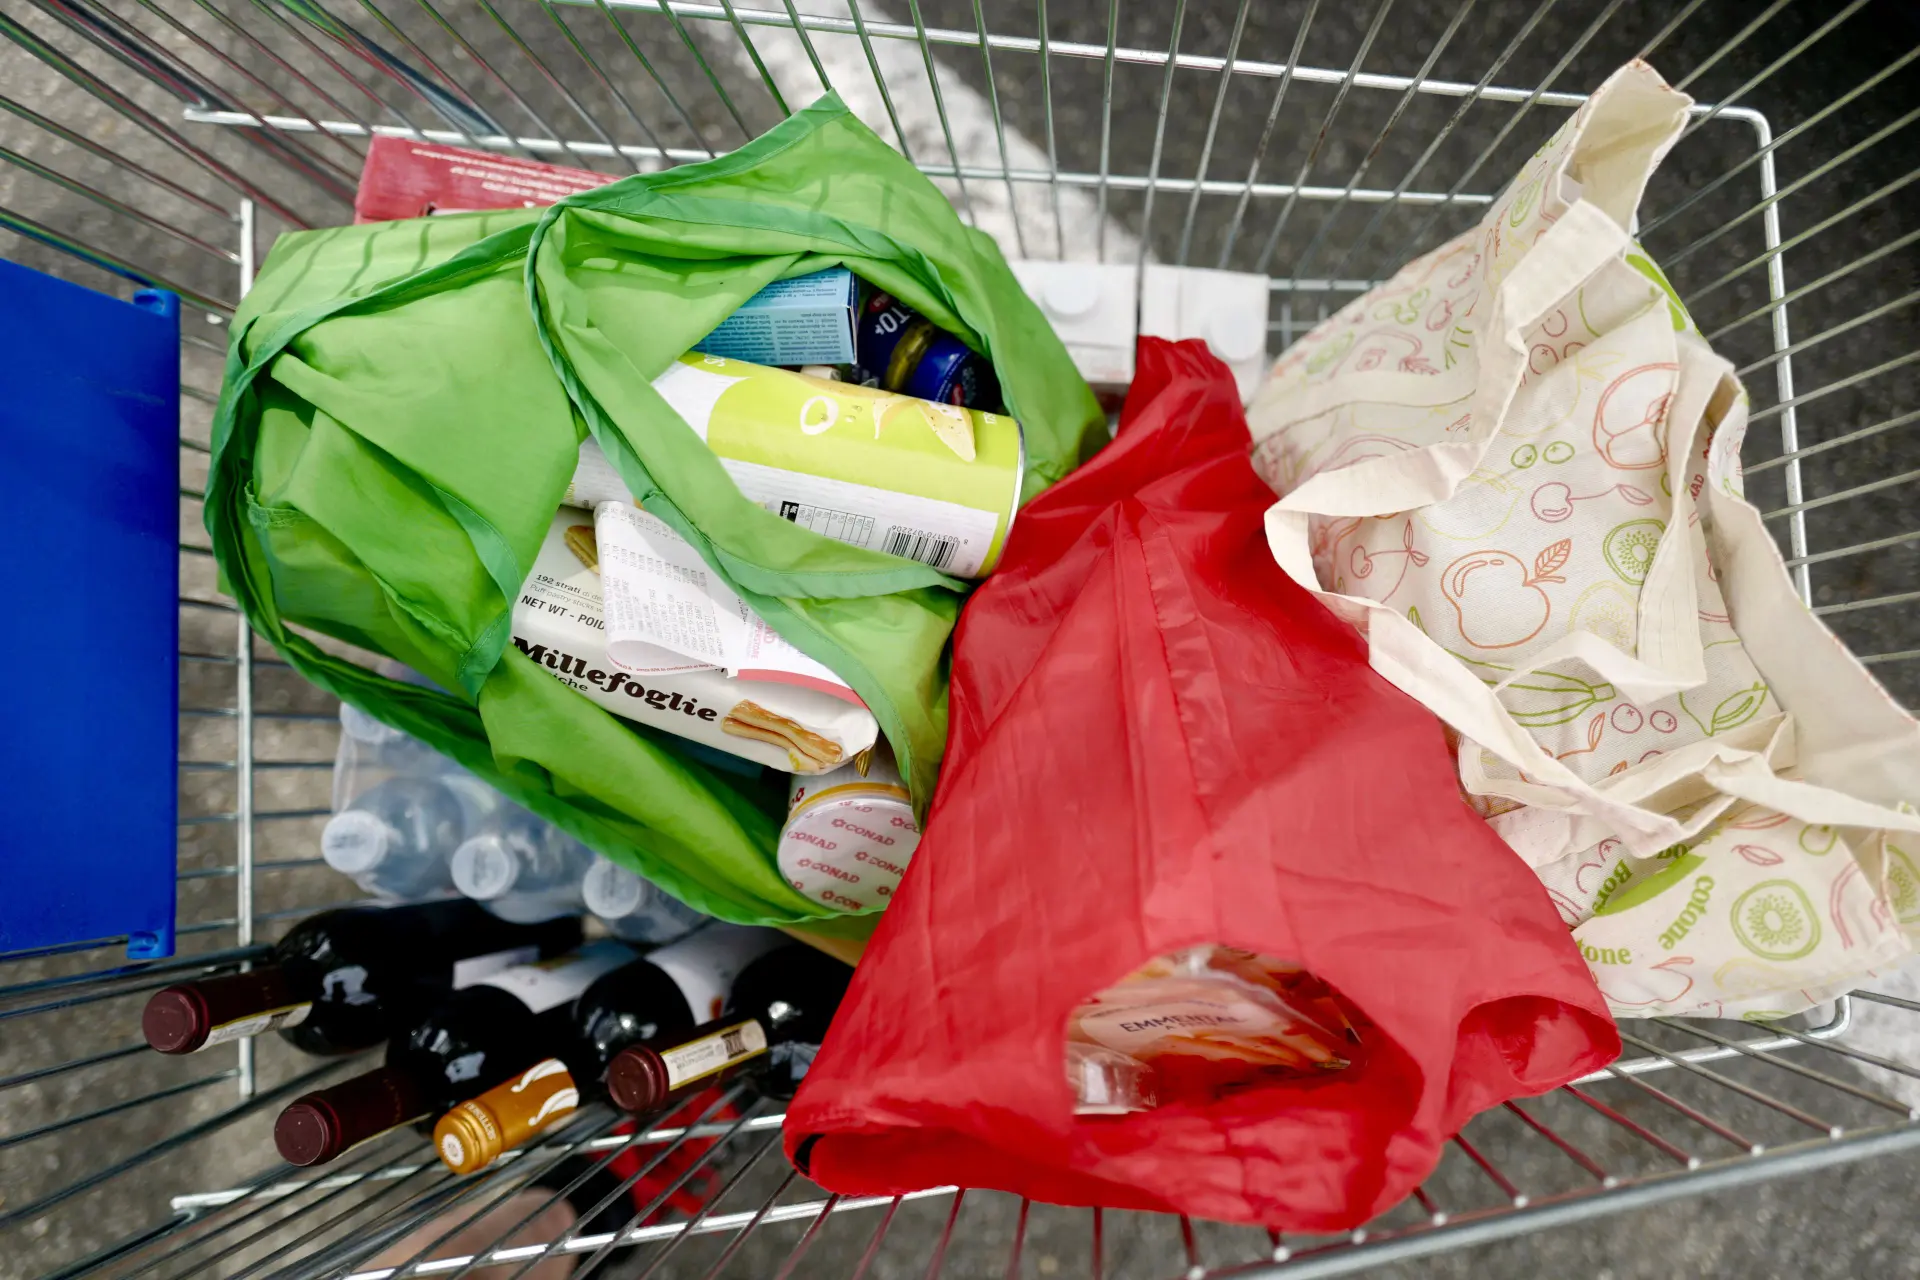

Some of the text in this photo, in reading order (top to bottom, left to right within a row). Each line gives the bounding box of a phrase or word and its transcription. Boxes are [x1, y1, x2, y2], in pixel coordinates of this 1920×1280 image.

[530, 583, 546, 593] Puff
[546, 589, 571, 602] pastry
[536, 574, 554, 584] 192
[555, 580, 581, 594] strati
[521, 595, 547, 609] NET
[548, 603, 568, 617] WT
[577, 614, 604, 630] POID
[513, 636, 718, 722] Millefoglie
[845, 823, 896, 846] CONAD
[811, 863, 860, 884] CONAD
[868, 857, 905, 877] CONA
[835, 896, 864, 910] CON
[1657, 875, 1716, 950] cotone
